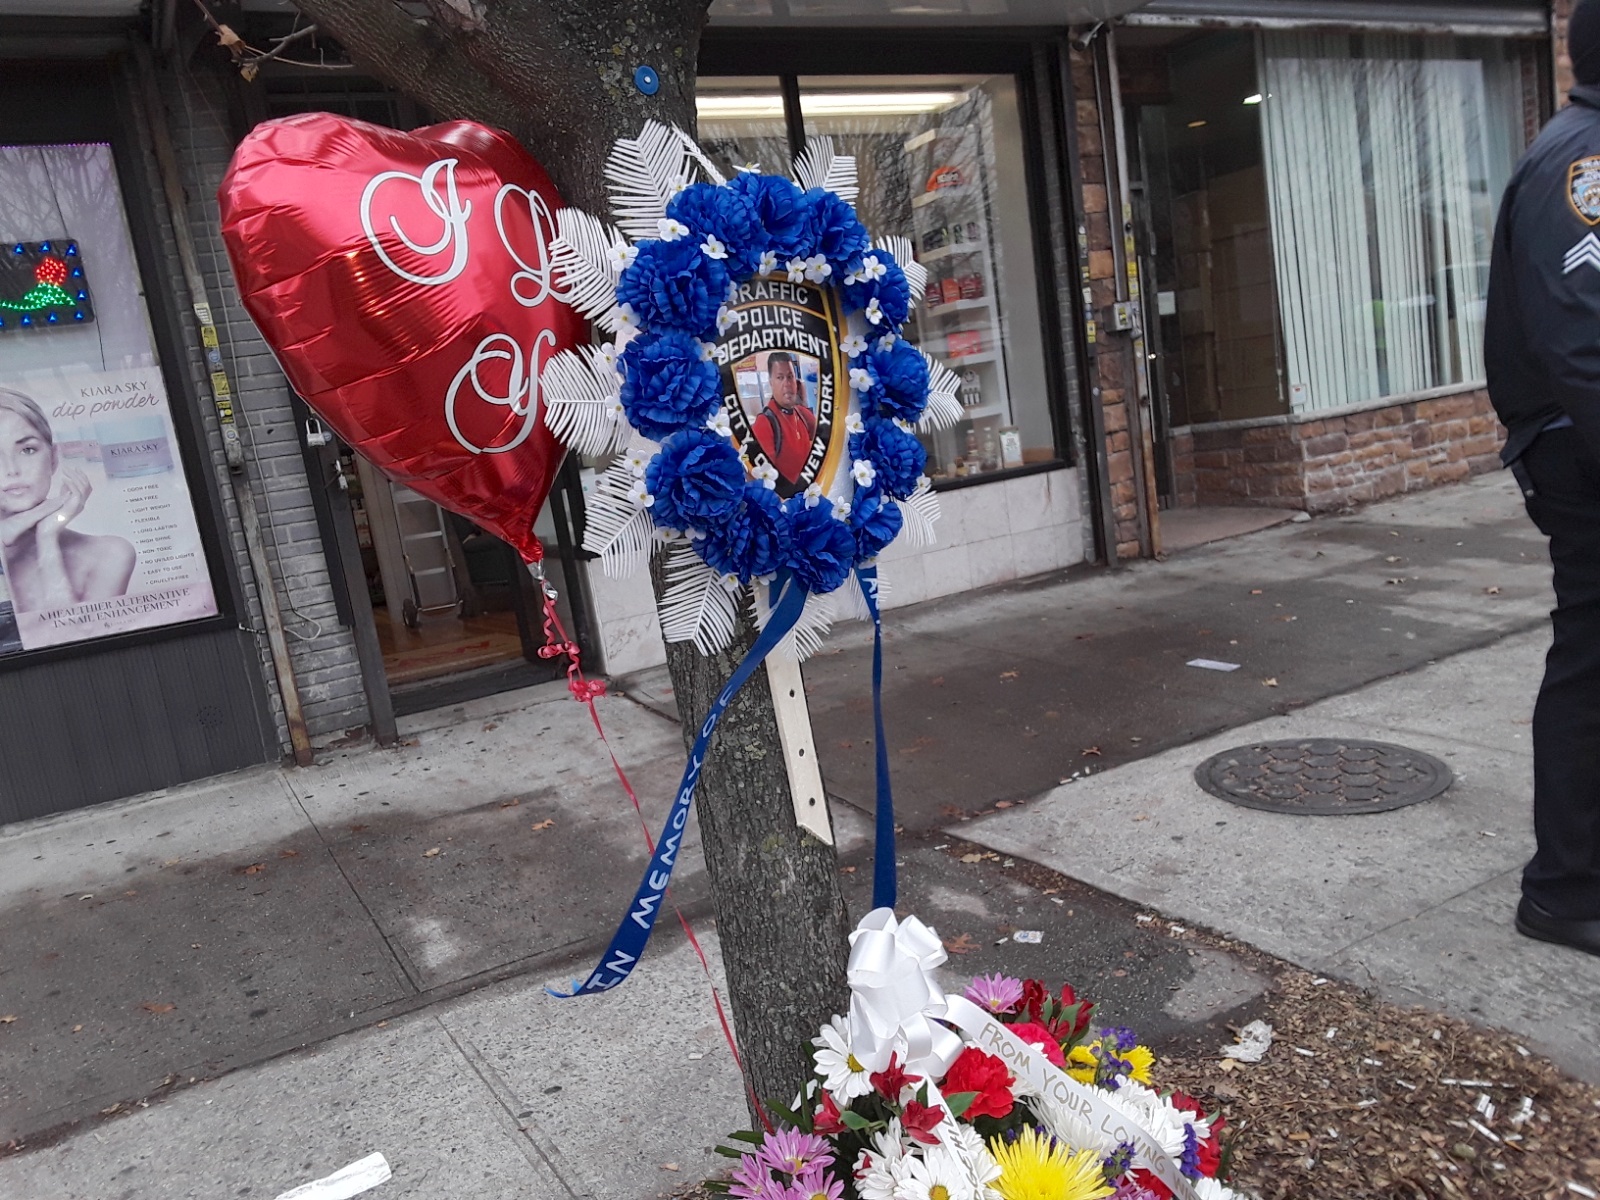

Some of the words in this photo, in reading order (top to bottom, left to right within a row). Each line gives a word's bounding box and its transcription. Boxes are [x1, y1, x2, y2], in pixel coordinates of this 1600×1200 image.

[737, 306, 804, 331] POLICE
[716, 328, 829, 366] DEPARTMENT
[52, 401, 86, 420] dip
[90, 392, 160, 417] powder
[724, 394, 754, 445] CITY
[800, 437, 826, 484] NEW
[819, 374, 832, 426] YORK
[38, 613, 46, 622] A
[48, 601, 113, 620] HEALTHIER
[116, 588, 190, 607] ALTERNATIVE
[54, 619, 66, 628] IN
[68, 614, 95, 626] NAIL
[97, 600, 181, 621] ENHANCEMENT
[587, 950, 635, 990] IN
[631, 754, 702, 930] MEMORY
[703, 685, 732, 738] OF
[980, 1022, 1031, 1074] FROM
[1042, 1068, 1092, 1125] YOUR
[1101, 1114, 1166, 1175] LOVING
